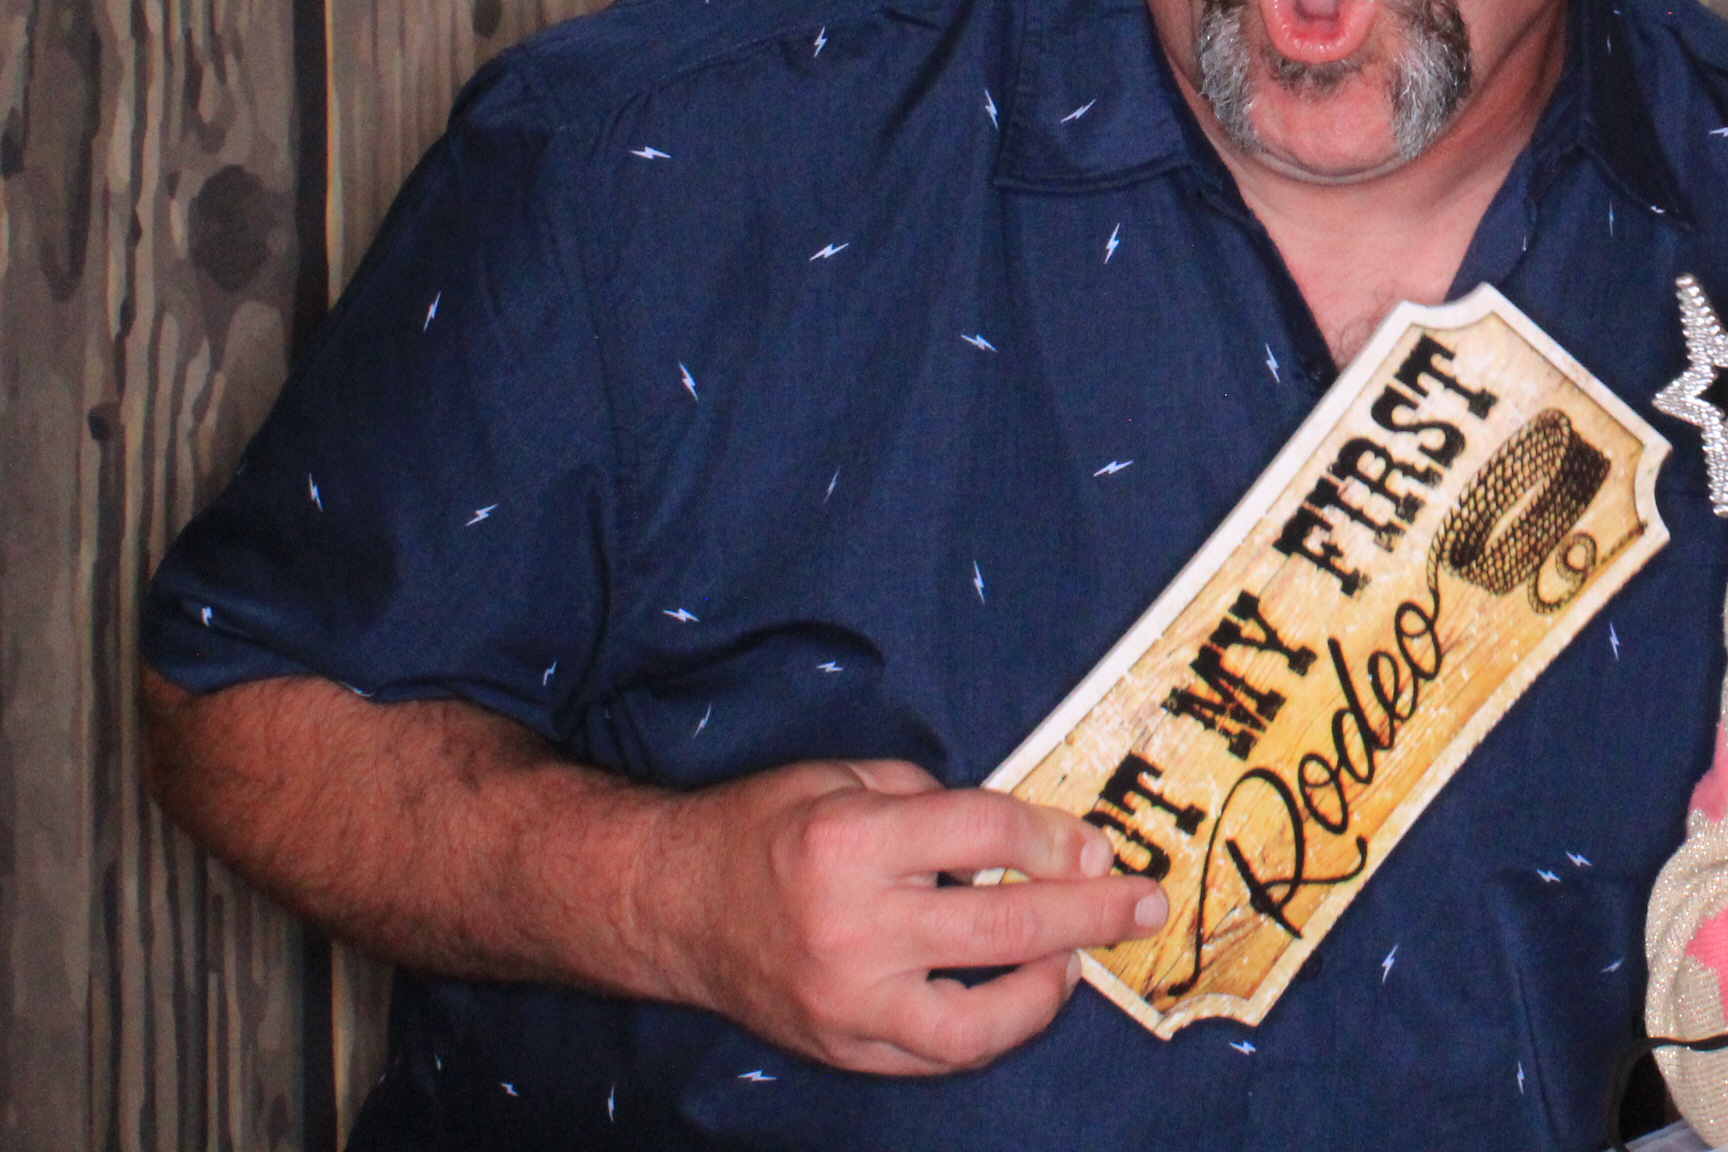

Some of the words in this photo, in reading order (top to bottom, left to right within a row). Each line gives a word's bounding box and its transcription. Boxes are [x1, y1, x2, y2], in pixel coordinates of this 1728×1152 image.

[1083, 754, 1207, 950] OT
[1162, 590, 1318, 762] MY
[1273, 334, 1501, 598] FIRST
[1166, 592, 1450, 997] Rodeo
